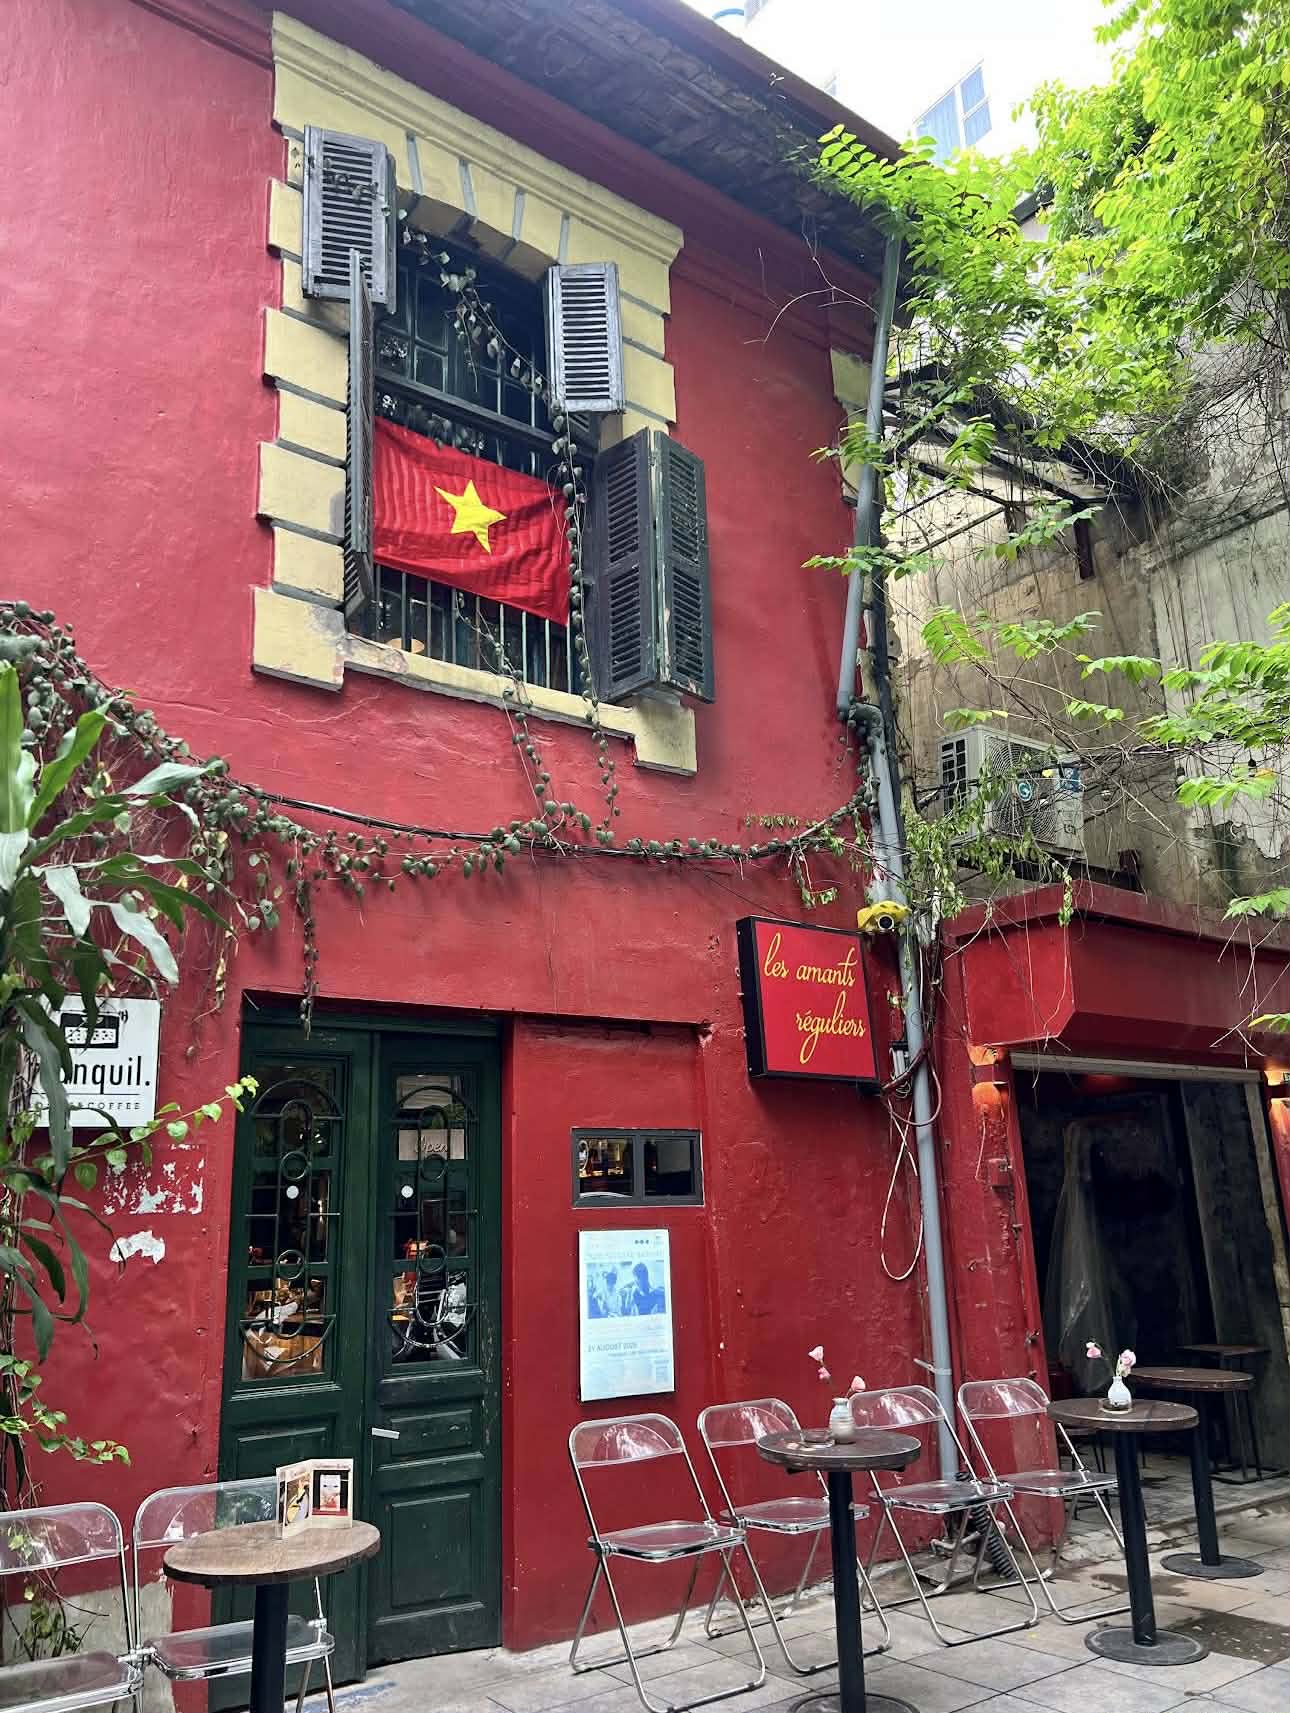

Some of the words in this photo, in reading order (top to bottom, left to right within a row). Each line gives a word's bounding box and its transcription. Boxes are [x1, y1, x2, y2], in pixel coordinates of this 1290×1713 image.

[764, 932, 789, 978] les
[796, 947, 858, 987] amants
[795, 990, 866, 1064] réguliers
[414, 1134, 448, 1153] Open
